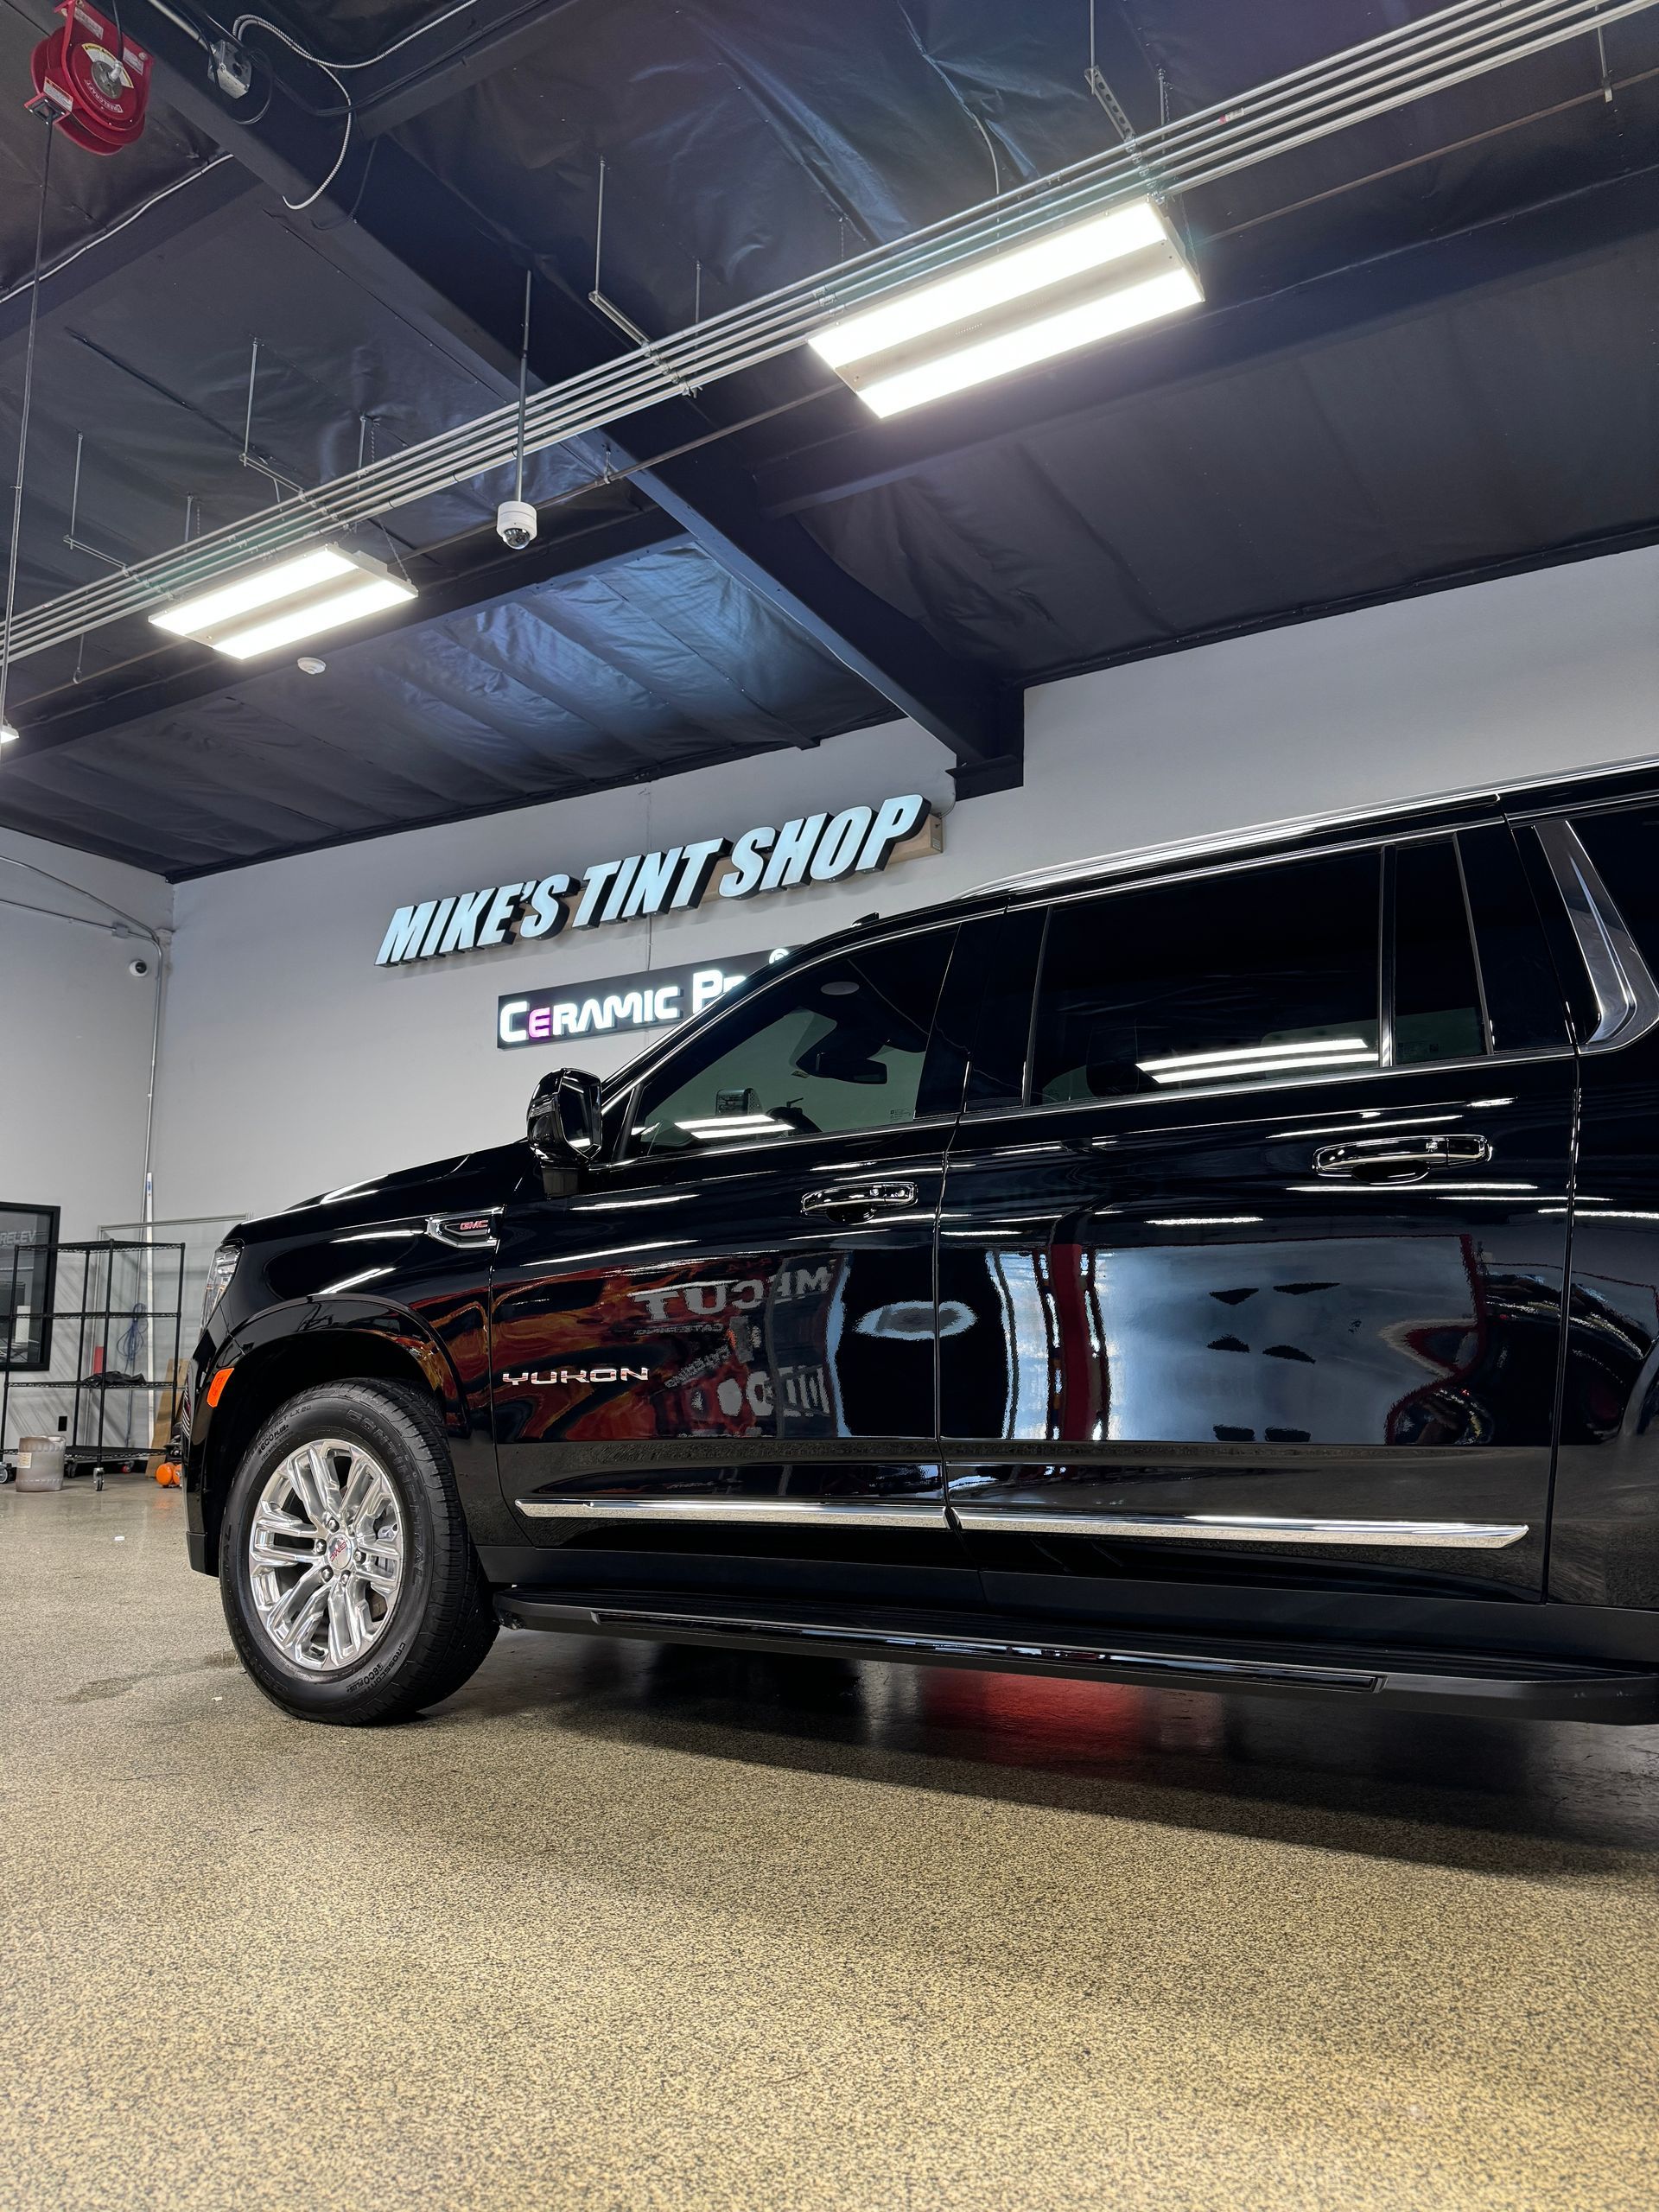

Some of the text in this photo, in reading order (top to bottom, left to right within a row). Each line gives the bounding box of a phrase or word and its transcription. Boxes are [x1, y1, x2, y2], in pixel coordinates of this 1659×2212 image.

[374, 794, 926, 966] MIKE'S TINT SHOP
[499, 985, 680, 1042] CERAMIC
[460, 1219, 489, 1230] GMC
[502, 1367, 650, 1386] YUKON
[330, 1541, 347, 1562] GMC
